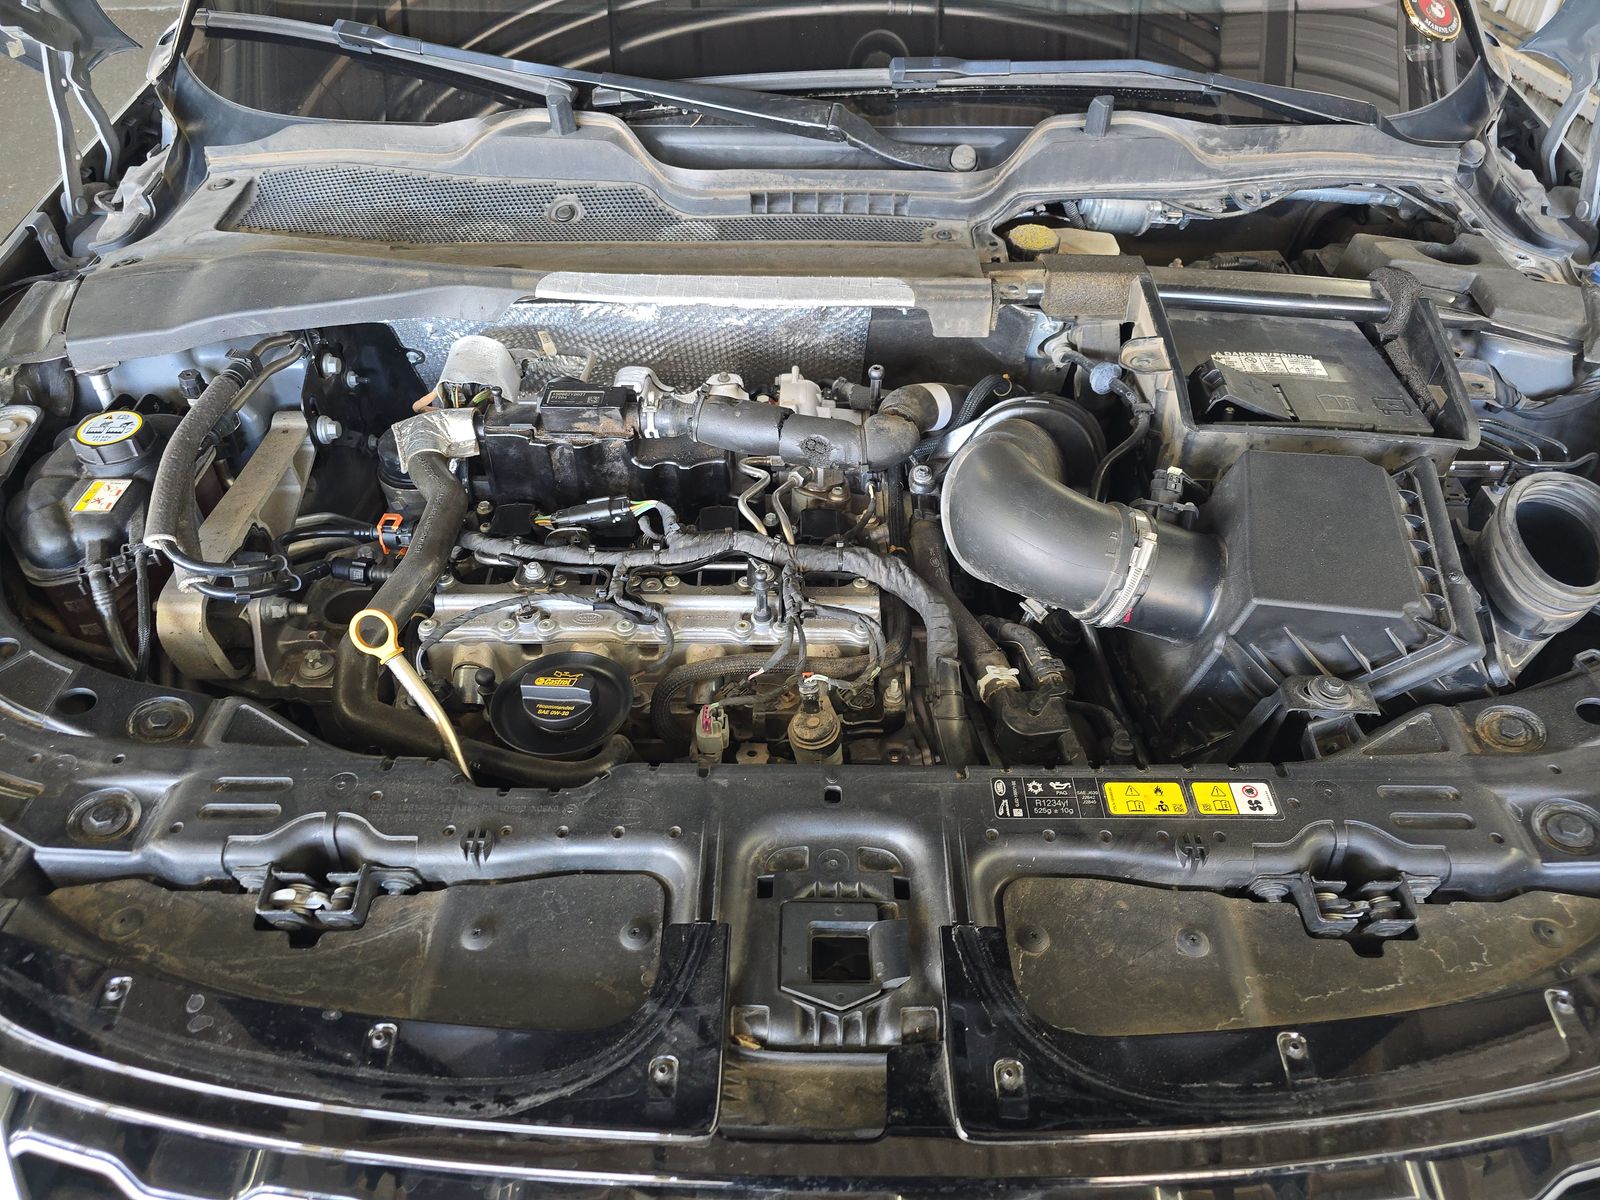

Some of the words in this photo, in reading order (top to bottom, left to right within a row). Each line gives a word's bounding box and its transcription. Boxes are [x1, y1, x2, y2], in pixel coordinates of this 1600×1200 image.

[1424, 18, 1449, 33] MARINE
[1224, 351, 1312, 359] DANGER/POISON
[544, 678, 571, 686] Castrol
[1035, 799, 1069, 808] R1234yf
